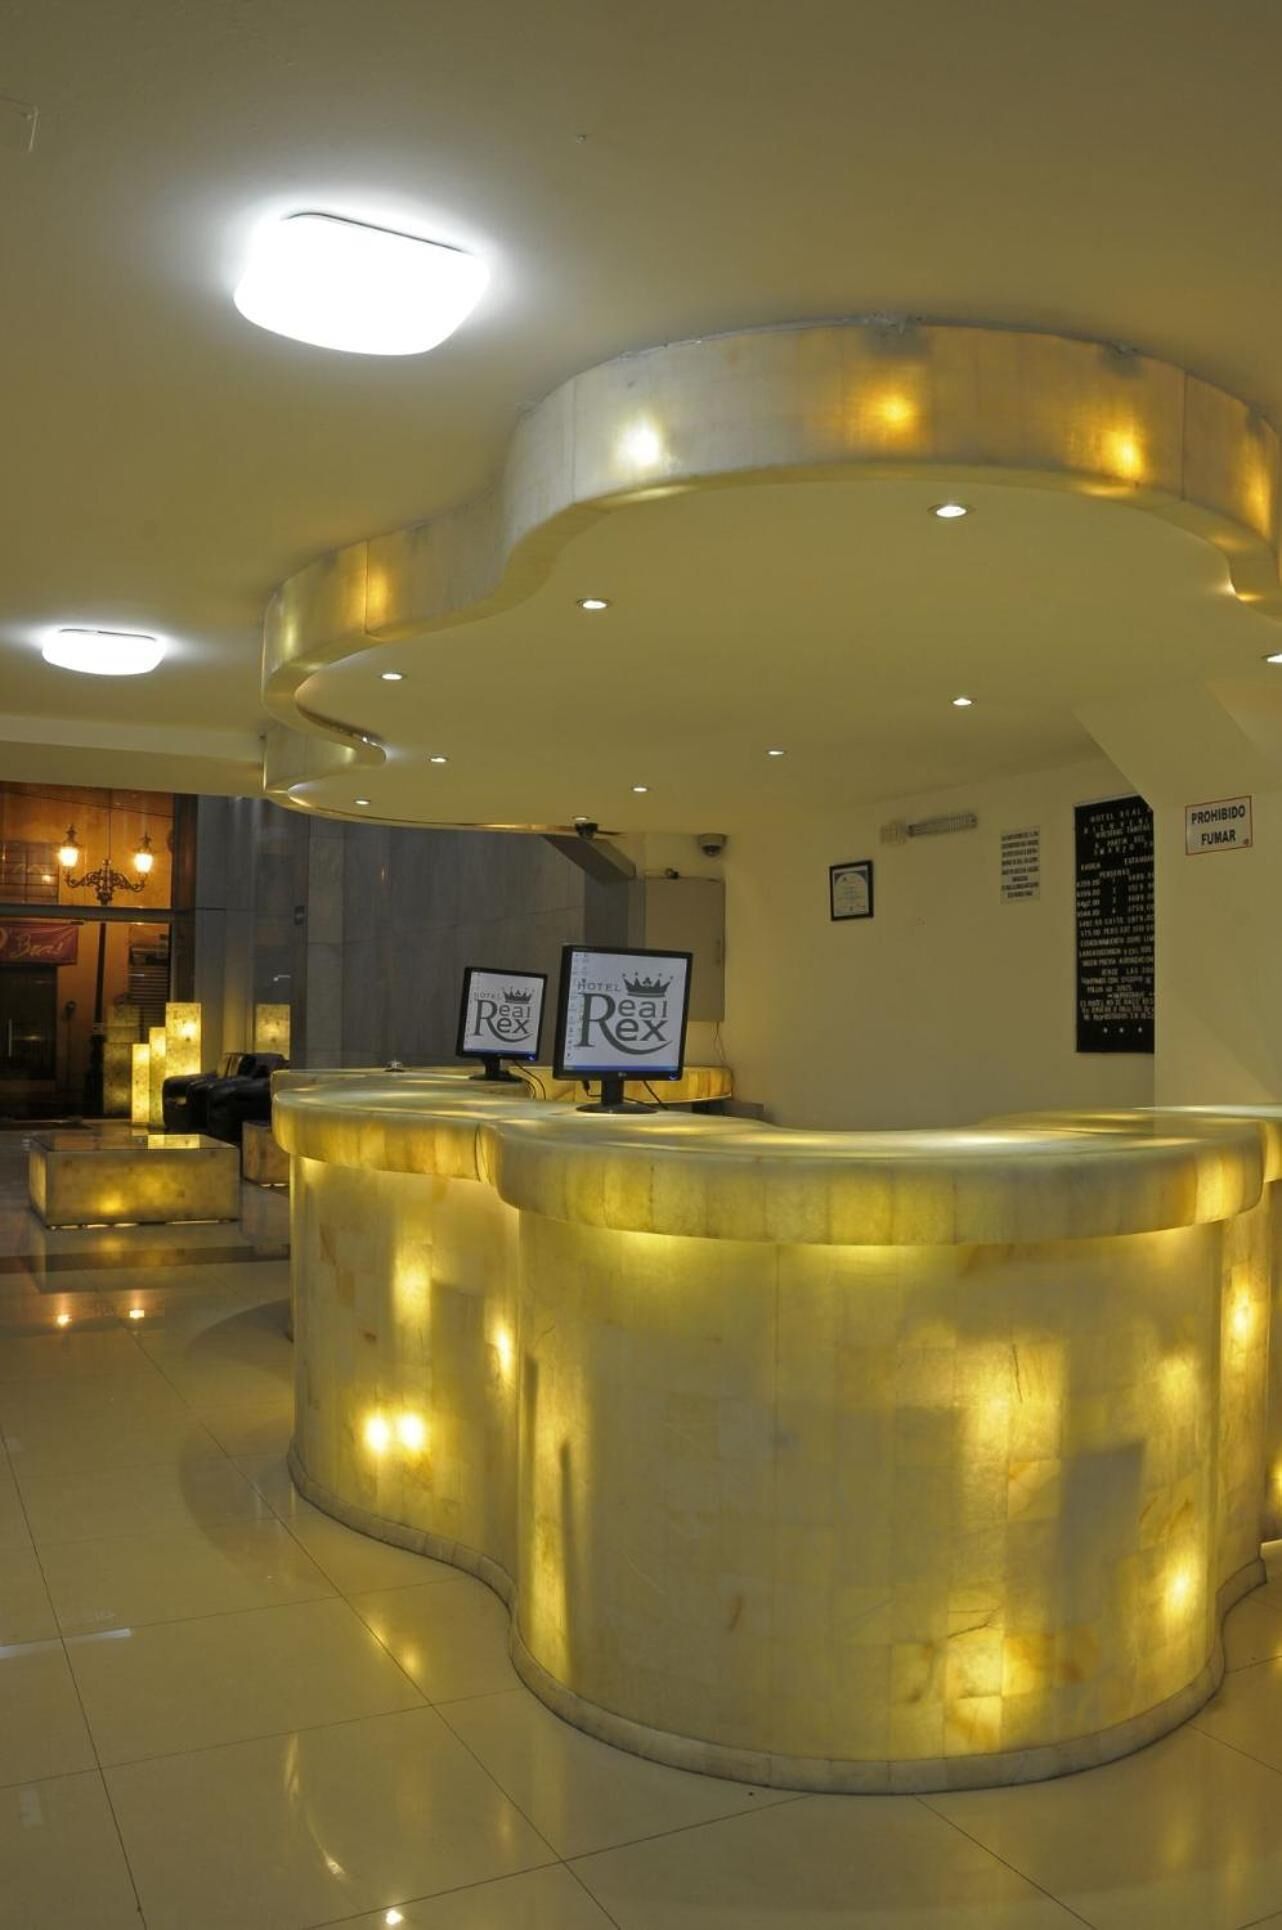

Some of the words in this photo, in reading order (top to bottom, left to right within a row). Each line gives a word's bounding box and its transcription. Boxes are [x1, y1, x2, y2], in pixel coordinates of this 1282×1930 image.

[1191, 805, 1246, 824] PROHIBIDO
[1201, 829, 1236, 846] FUMAR
[577, 981, 620, 991] HOTEL
